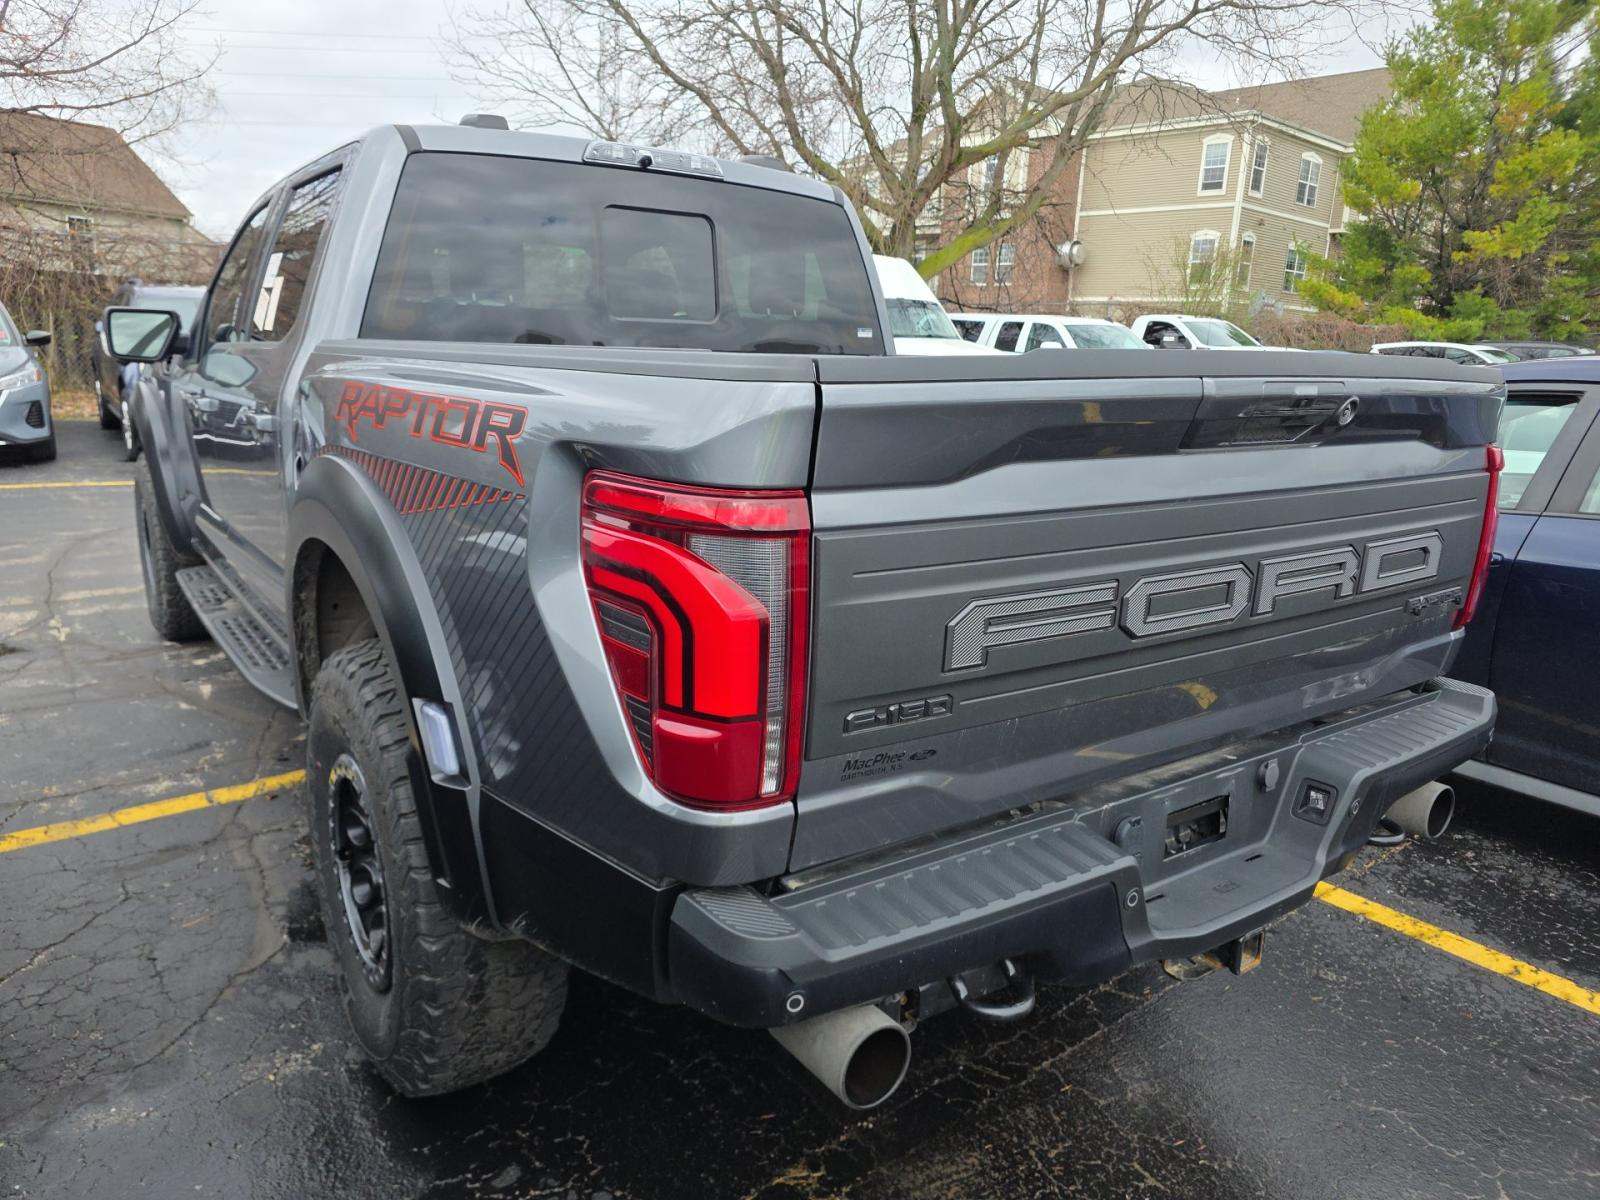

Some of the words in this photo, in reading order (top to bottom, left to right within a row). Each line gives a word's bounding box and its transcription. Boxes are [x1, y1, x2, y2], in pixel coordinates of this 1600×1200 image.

[335, 381, 529, 488] RAPTOR
[941, 529, 1446, 674] FORD
[842, 751, 906, 773] MacPhee
